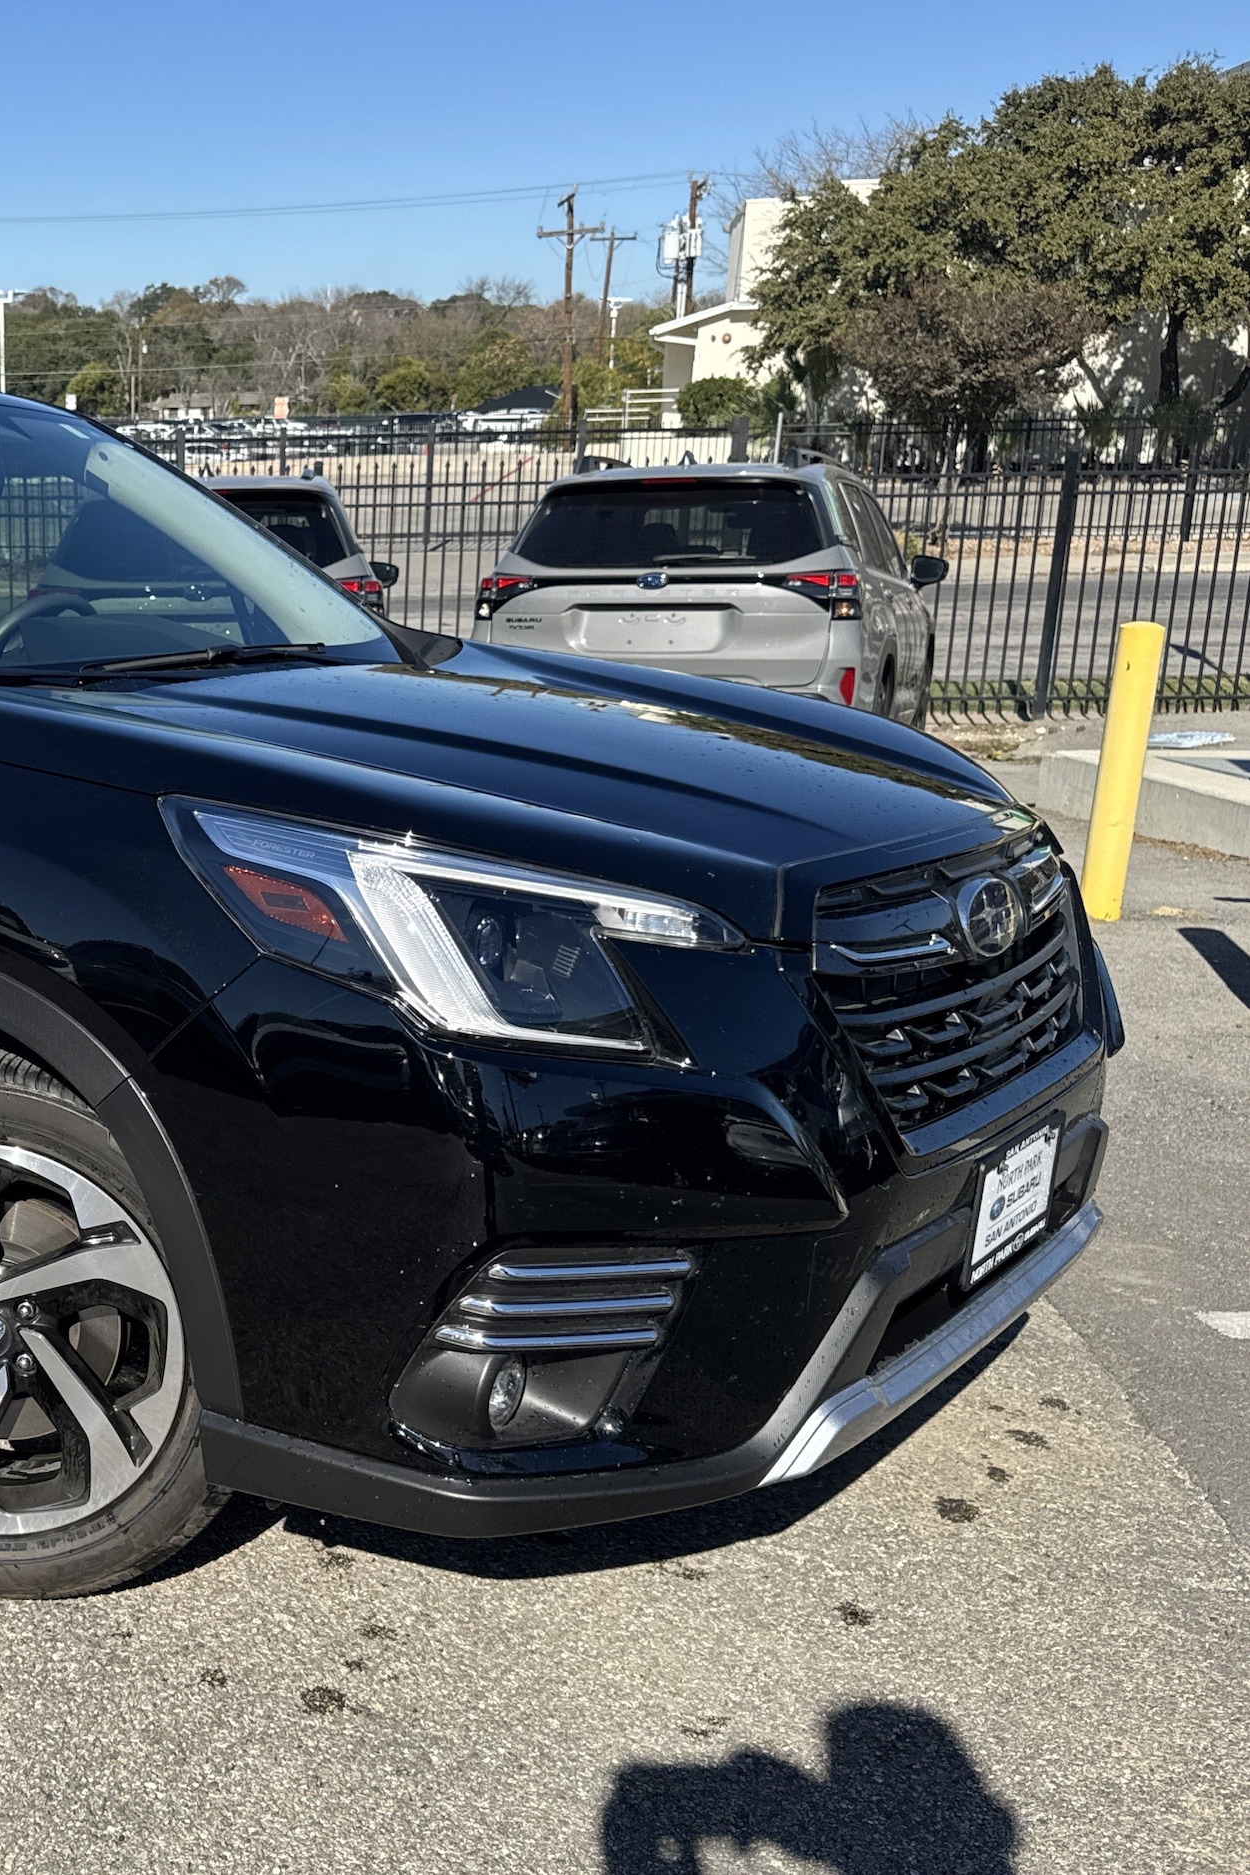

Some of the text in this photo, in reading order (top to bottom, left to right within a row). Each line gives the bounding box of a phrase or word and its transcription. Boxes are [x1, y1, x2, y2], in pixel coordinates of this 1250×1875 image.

[253, 838, 316, 858] FORESTER
[1005, 1143, 1020, 1160] SAN
[997, 1150, 1043, 1194] NORTH PARK
[1006, 1171, 1041, 1208] SUBARU
[984, 1199, 1038, 1248] SAN ANTONIO
[970, 1255, 995, 1285] NORTH
[994, 1241, 1014, 1266] PARK
